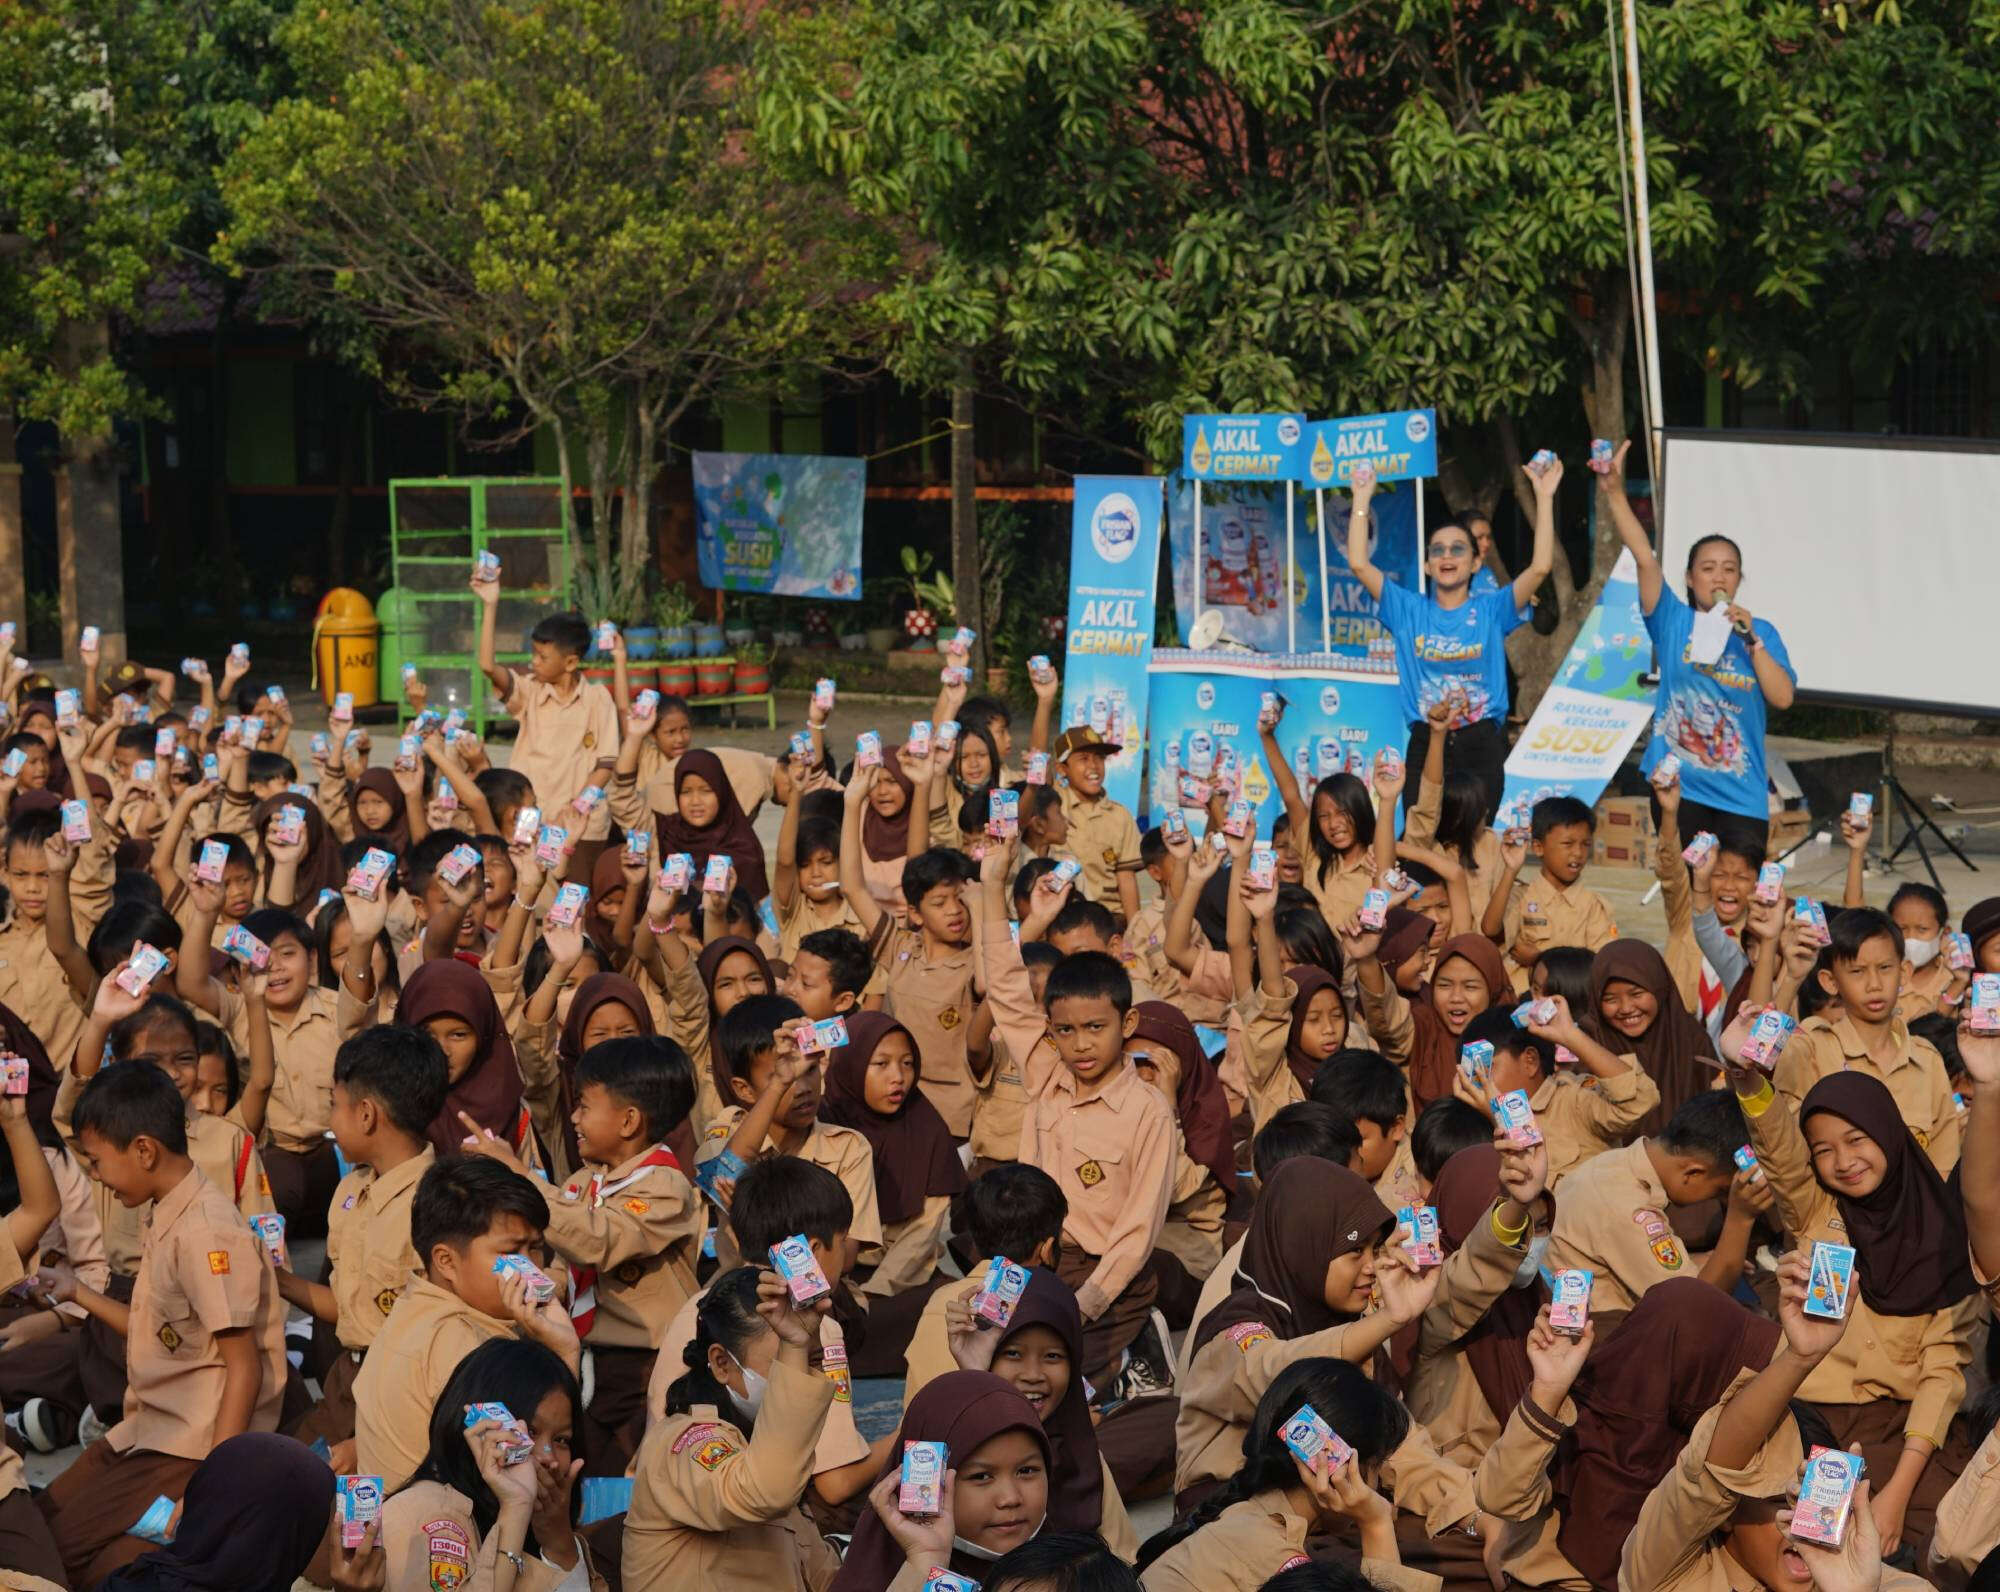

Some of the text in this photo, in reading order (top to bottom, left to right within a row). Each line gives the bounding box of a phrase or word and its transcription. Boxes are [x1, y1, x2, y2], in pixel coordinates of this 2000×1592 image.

[1213, 429, 1261, 452] AKAL
[1335, 430, 1389, 457] AKAL
[1213, 454, 1282, 476] CERMAT
[1337, 453, 1411, 481] CEMAT
[724, 541, 773, 566] SUSU
[1079, 600, 1138, 628] AKAL
[1068, 631, 1149, 657] CERMAT
[1553, 702, 1614, 717] RAYAKAN
[1211, 722, 1240, 737] BARU
[1339, 728, 1368, 743] BARU
[1530, 725, 1624, 755] SUSU
[1821, 1463, 1845, 1473] FRISIAN
[1824, 1470, 1840, 1478] FLAG
